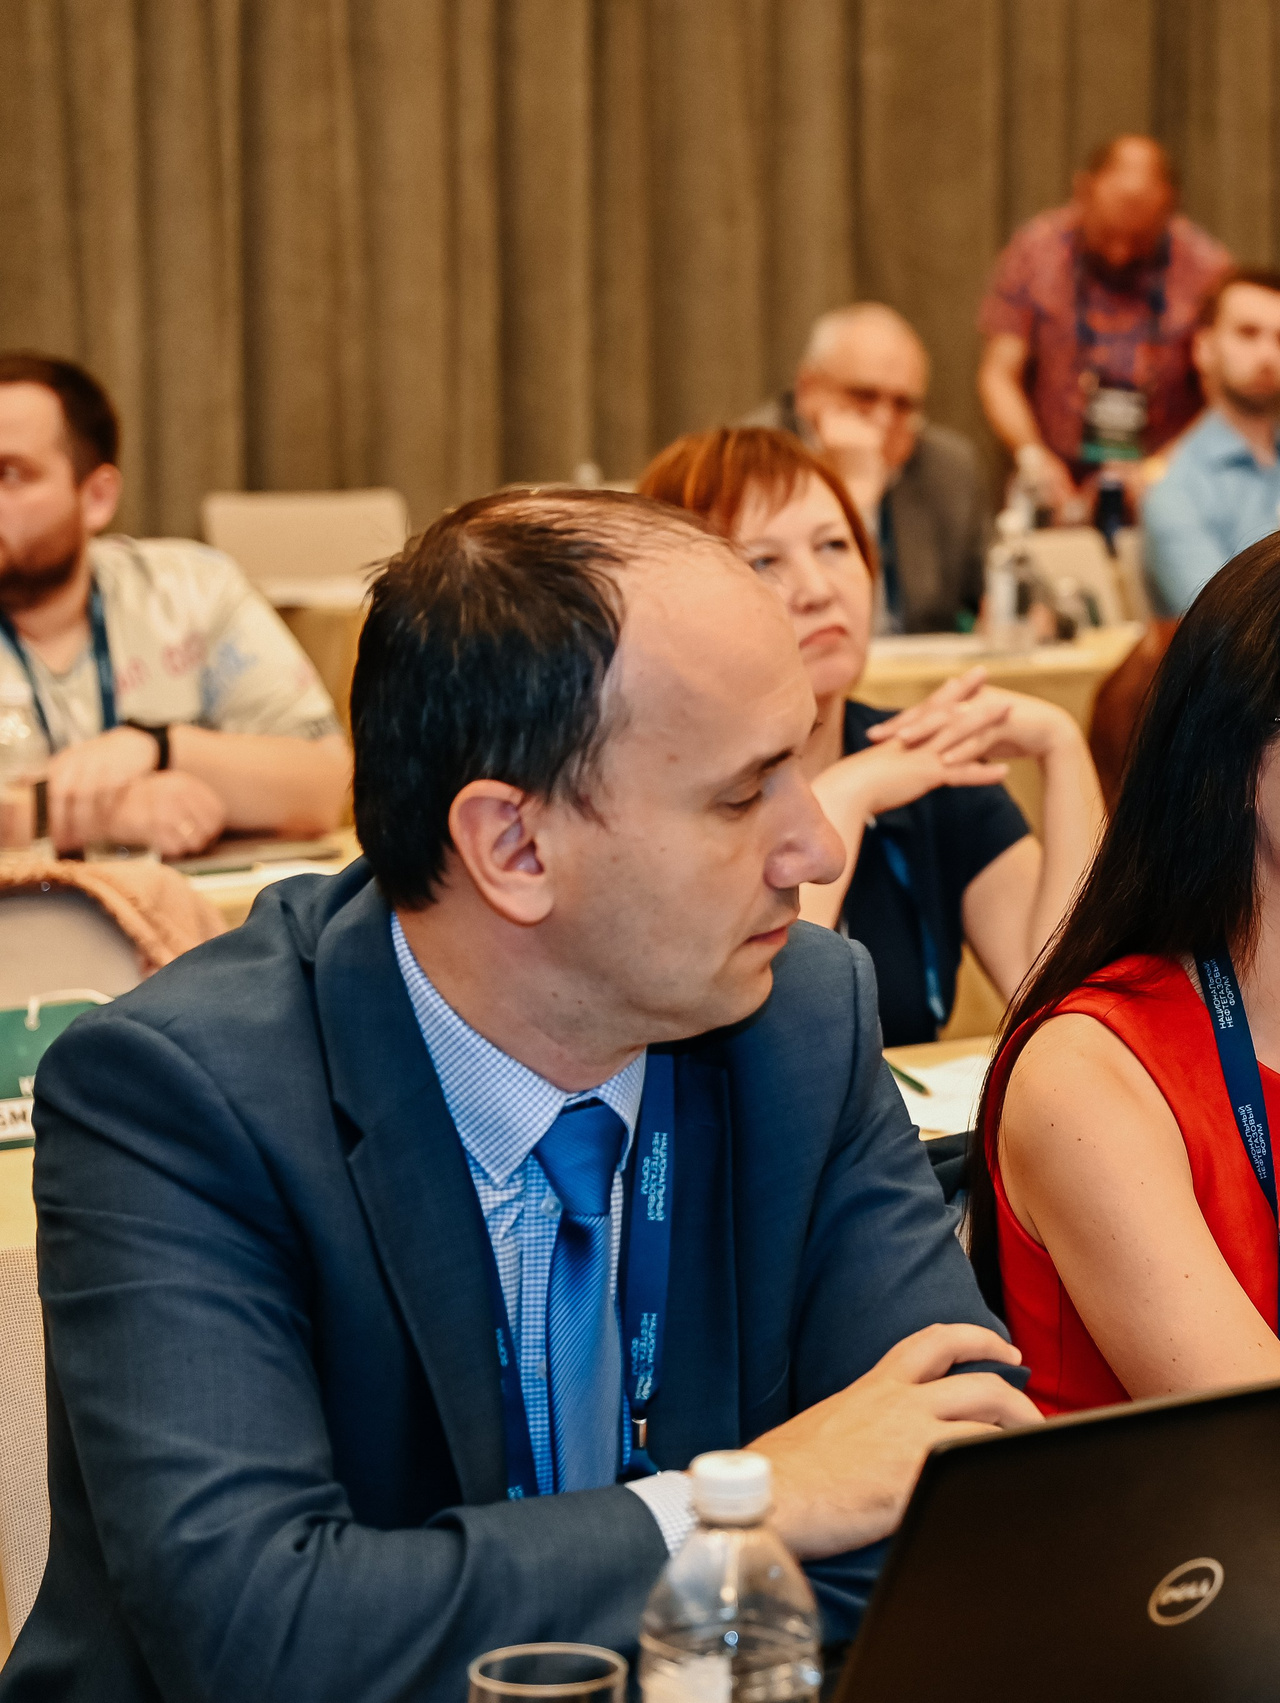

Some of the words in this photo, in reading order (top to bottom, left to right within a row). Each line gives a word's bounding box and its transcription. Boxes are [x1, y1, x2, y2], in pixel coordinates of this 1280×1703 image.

[1238, 1105, 1263, 1180] НАЦИОНАЛЬНЫЙ
[1245, 1104, 1267, 1179] НЕФТЕГАЗОВЫЙ
[1256, 1123, 1267, 1155] ФОРУМ
